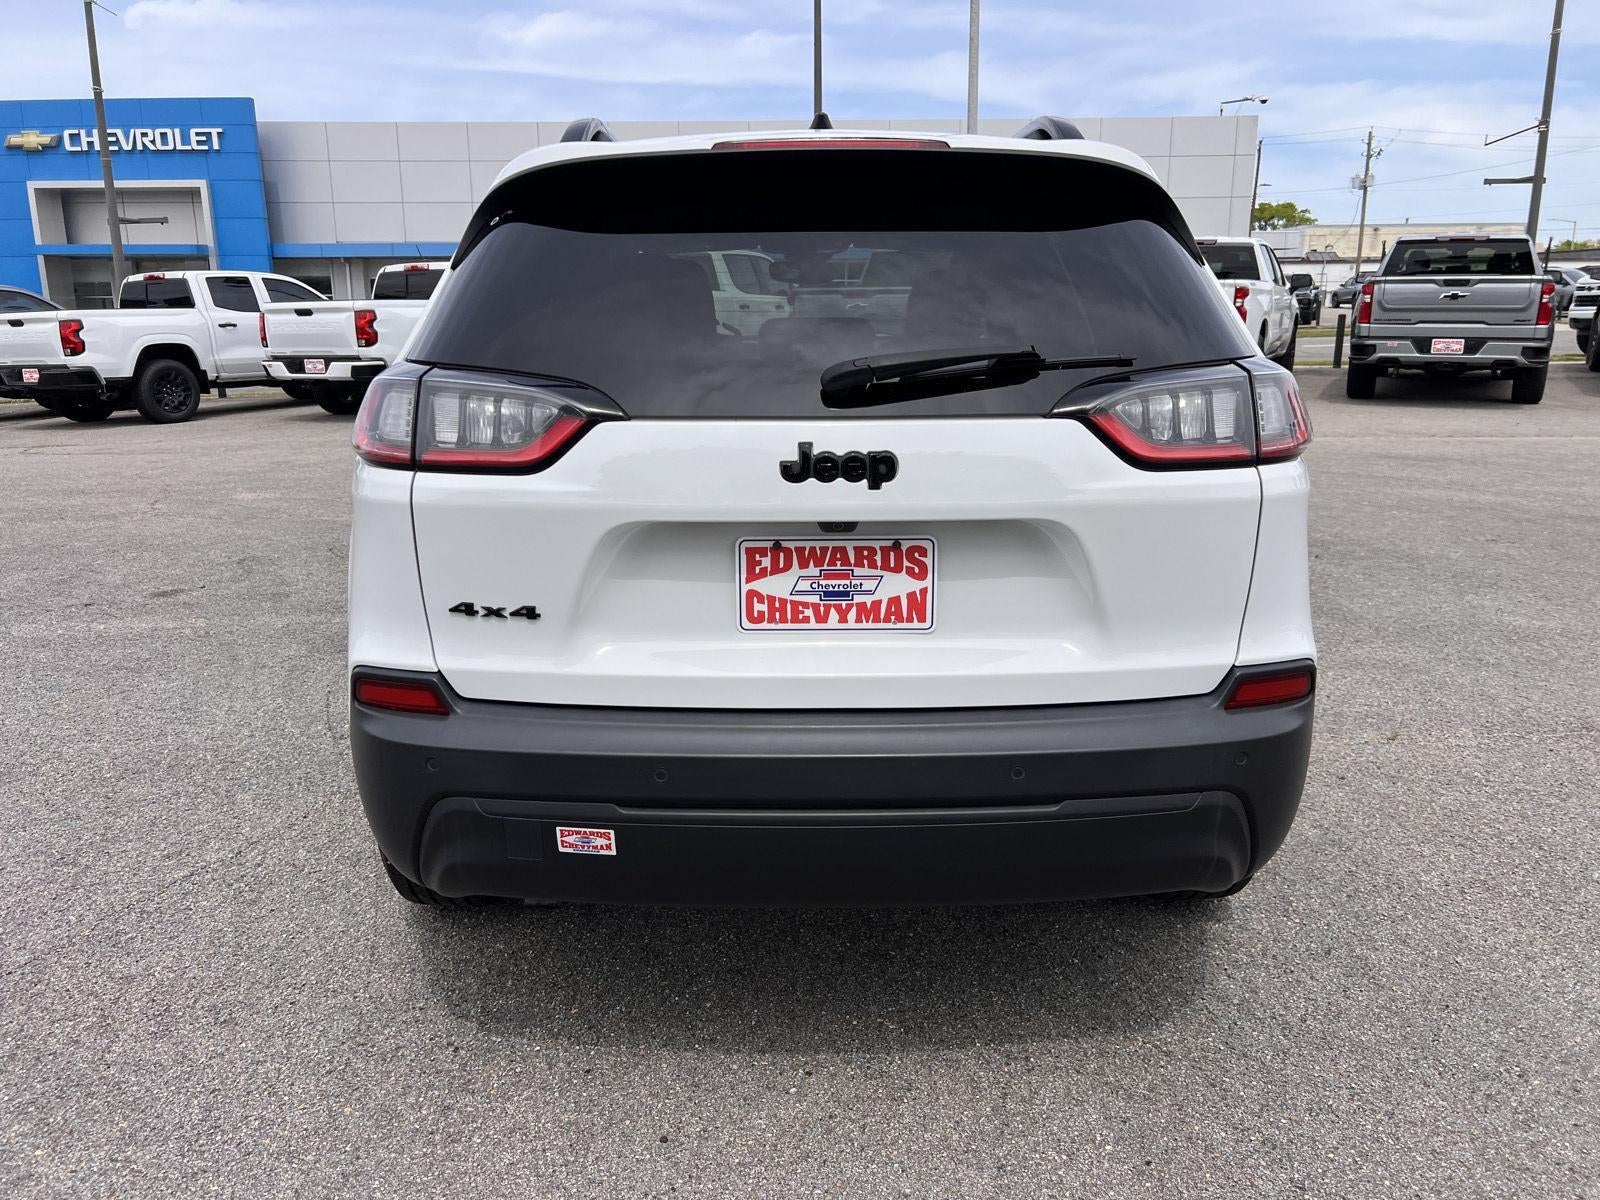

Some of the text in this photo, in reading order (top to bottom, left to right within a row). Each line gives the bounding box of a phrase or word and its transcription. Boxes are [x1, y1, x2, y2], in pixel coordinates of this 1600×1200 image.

[63, 128, 223, 151] CHEVROLET
[779, 441, 899, 490] Jeep
[744, 545, 929, 584] EDWARDS
[809, 581, 864, 591] Chevrolet
[448, 602, 541, 619] 4x4
[745, 586, 929, 624] CHEVYMAN
[560, 829, 611, 841] EDWARDS
[561, 839, 612, 851] CHEVYMAN
